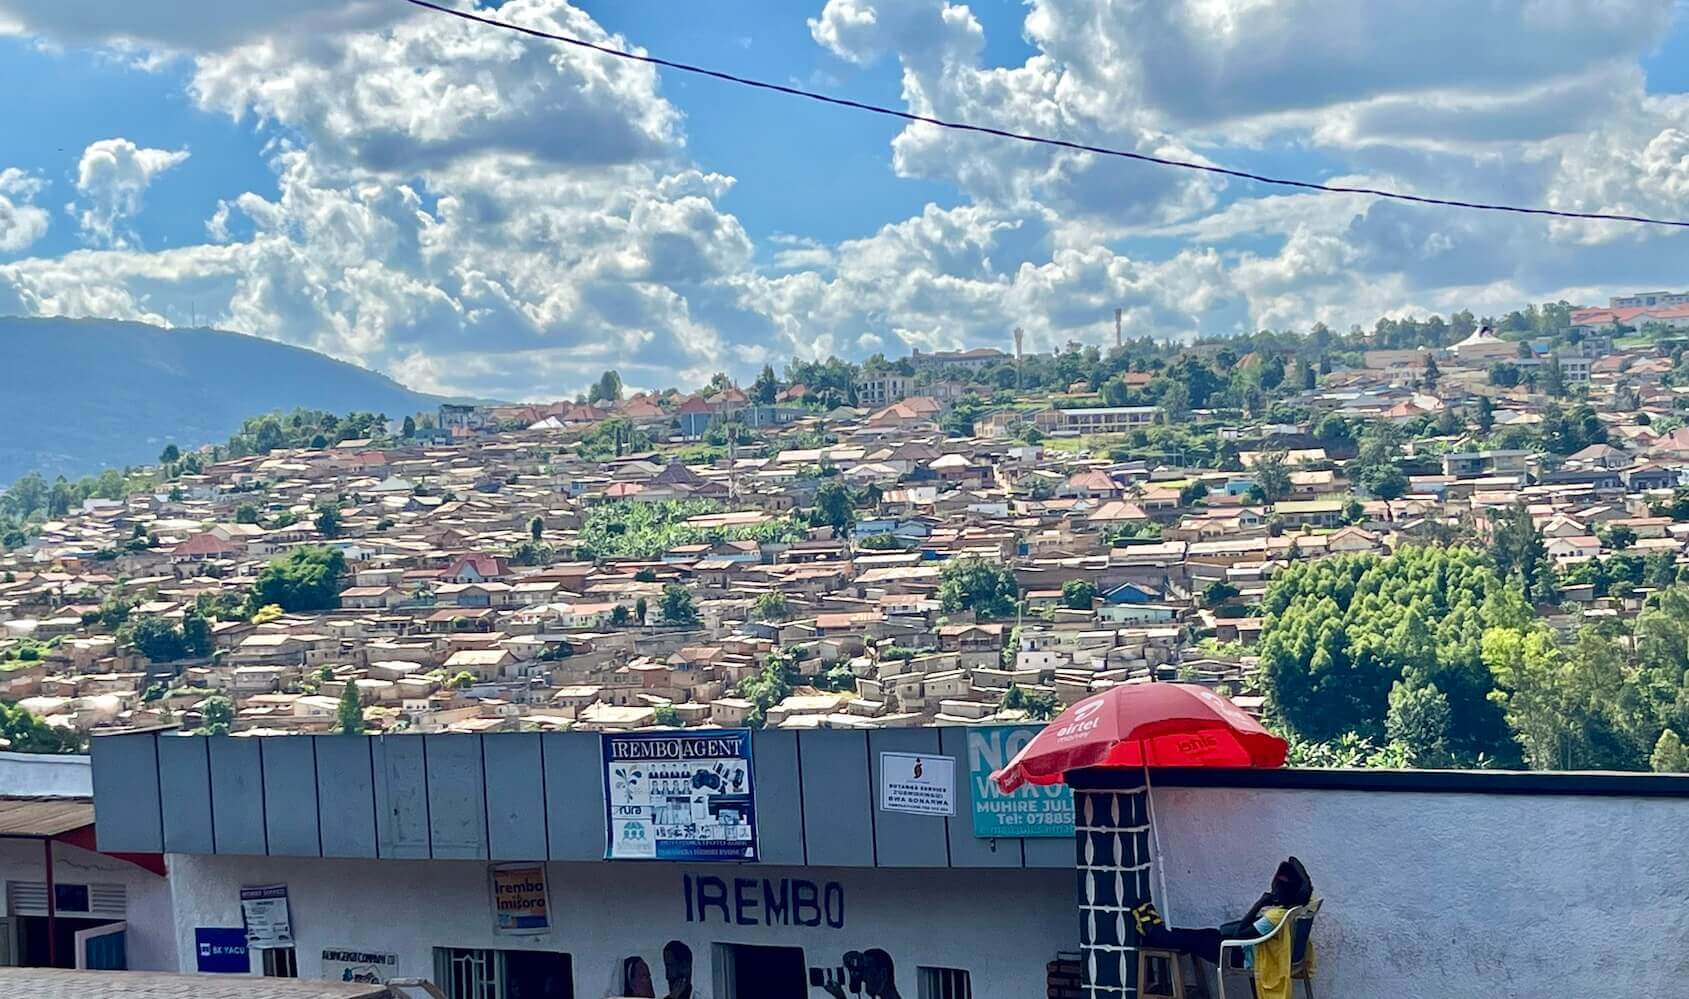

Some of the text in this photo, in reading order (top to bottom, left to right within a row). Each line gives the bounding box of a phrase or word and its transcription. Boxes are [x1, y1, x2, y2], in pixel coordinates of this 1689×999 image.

[1056, 717, 1100, 737] airtel
[611, 739, 742, 758] IREMBO AGENT
[908, 797, 949, 806] SONARWA
[976, 800, 1038, 813] MUHIRE
[997, 813, 1023, 825] Tel:
[495, 877, 544, 894] Irembo
[683, 873, 845, 929] IREMBO
[224, 946, 245, 954] YACU
